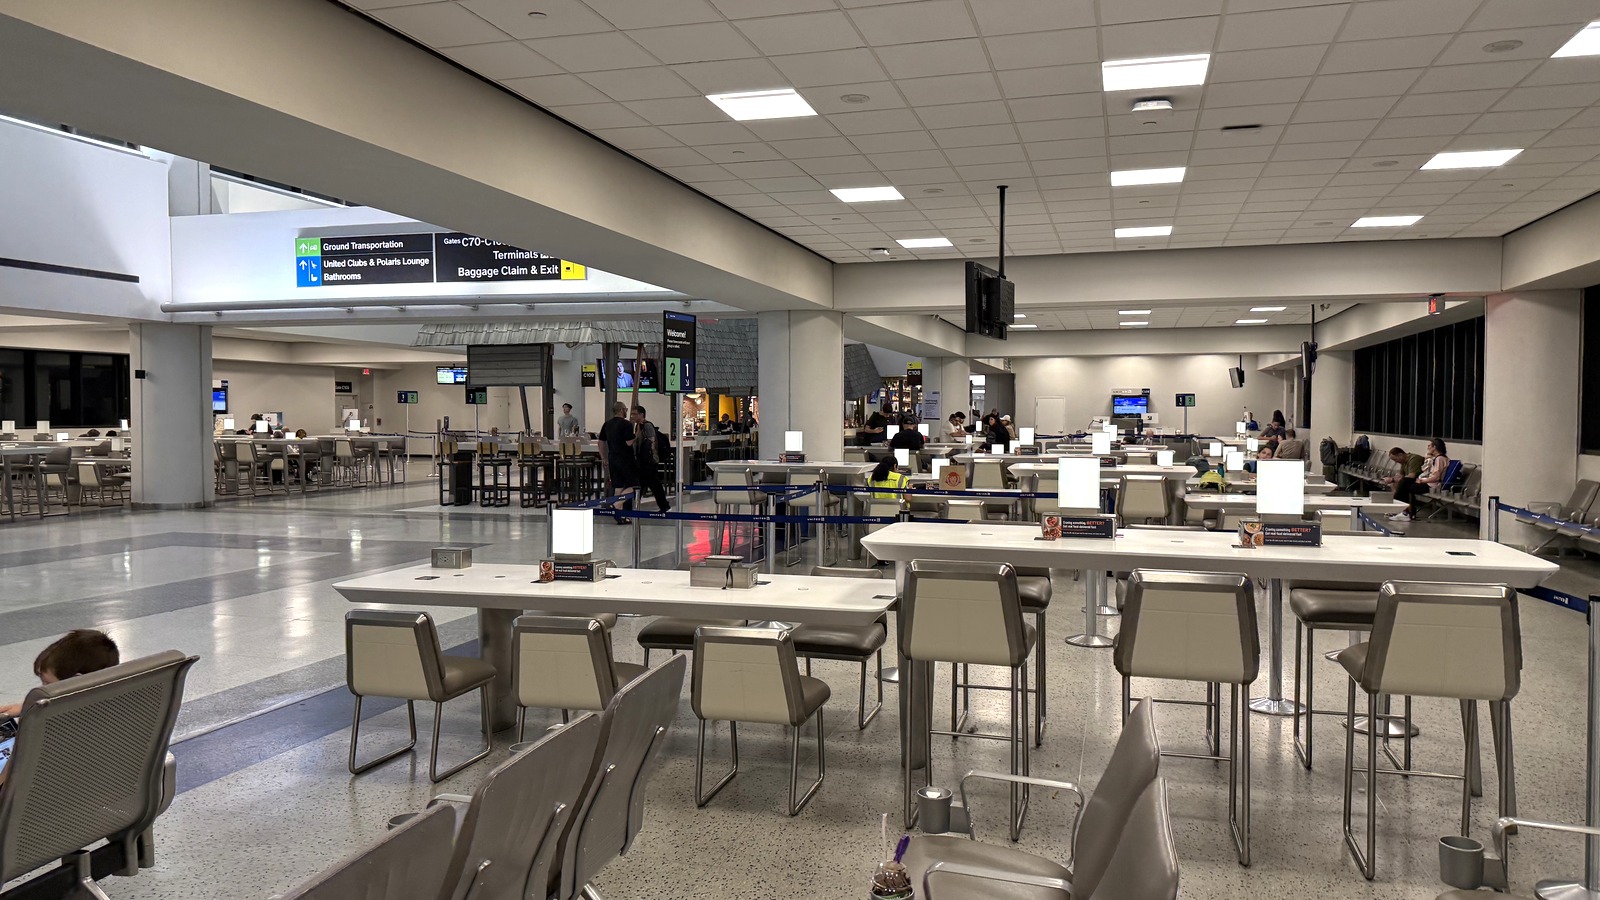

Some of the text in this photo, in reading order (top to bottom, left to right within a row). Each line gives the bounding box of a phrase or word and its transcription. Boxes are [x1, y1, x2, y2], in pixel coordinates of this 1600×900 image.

[323, 240, 404, 251] Ground Transportation
[443, 237, 461, 245] Gates
[492, 249, 539, 260] Terminals
[323, 256, 430, 268] United Clubs & Polaris Lounge
[323, 271, 362, 281] Bathrooms
[457, 264, 560, 279] Baggage Claim & Exit
[666, 328, 687, 339] Welcome!
[670, 362, 689, 377] 2 1
